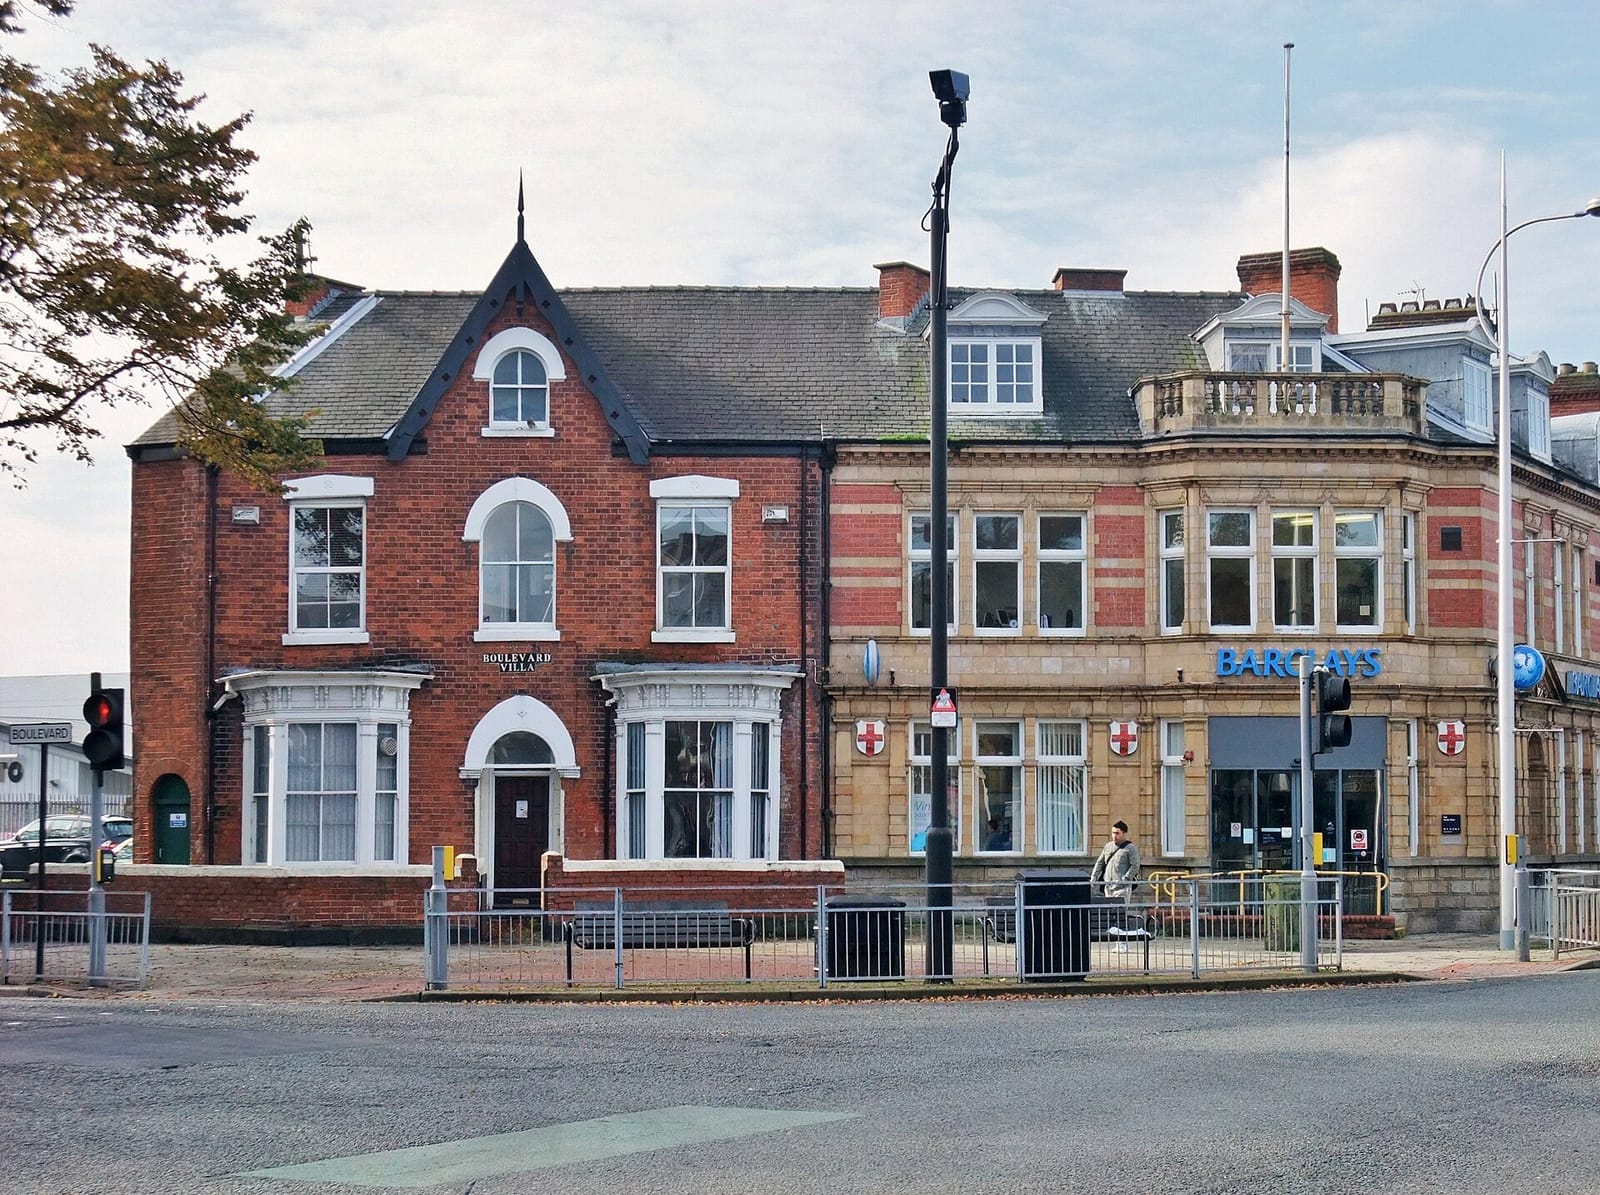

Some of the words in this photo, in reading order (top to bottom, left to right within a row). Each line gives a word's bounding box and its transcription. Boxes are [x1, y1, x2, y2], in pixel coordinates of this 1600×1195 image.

[483, 653, 551, 663] BOULEVARD
[500, 662, 535, 672] VILLA
[12, 727, 69, 740] BOULEVARD
